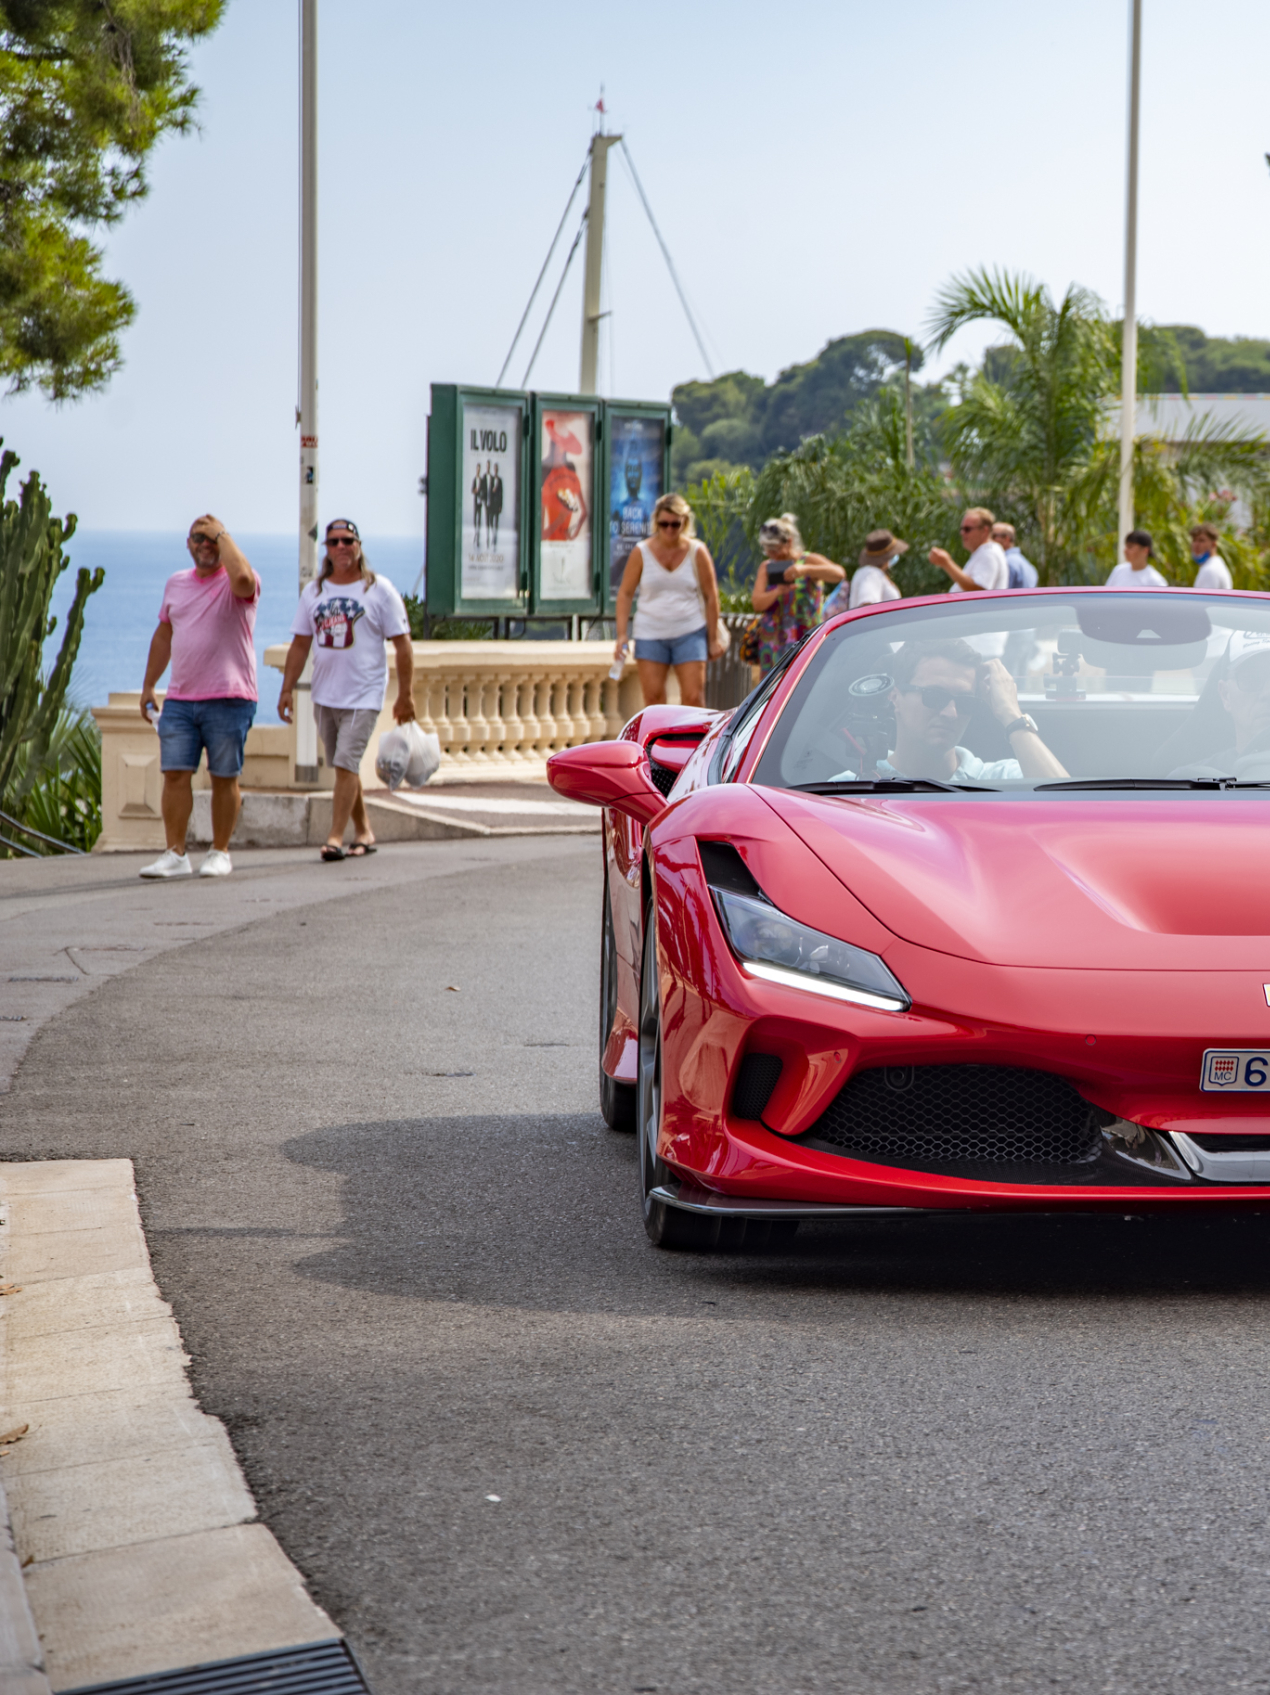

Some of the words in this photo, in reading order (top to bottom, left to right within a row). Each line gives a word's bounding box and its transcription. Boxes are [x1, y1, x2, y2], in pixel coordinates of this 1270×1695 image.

[470, 429, 479, 451] IL
[480, 429, 508, 453] VOLO
[622, 506, 643, 520] BACK
[1213, 1071, 1232, 1081] MC
